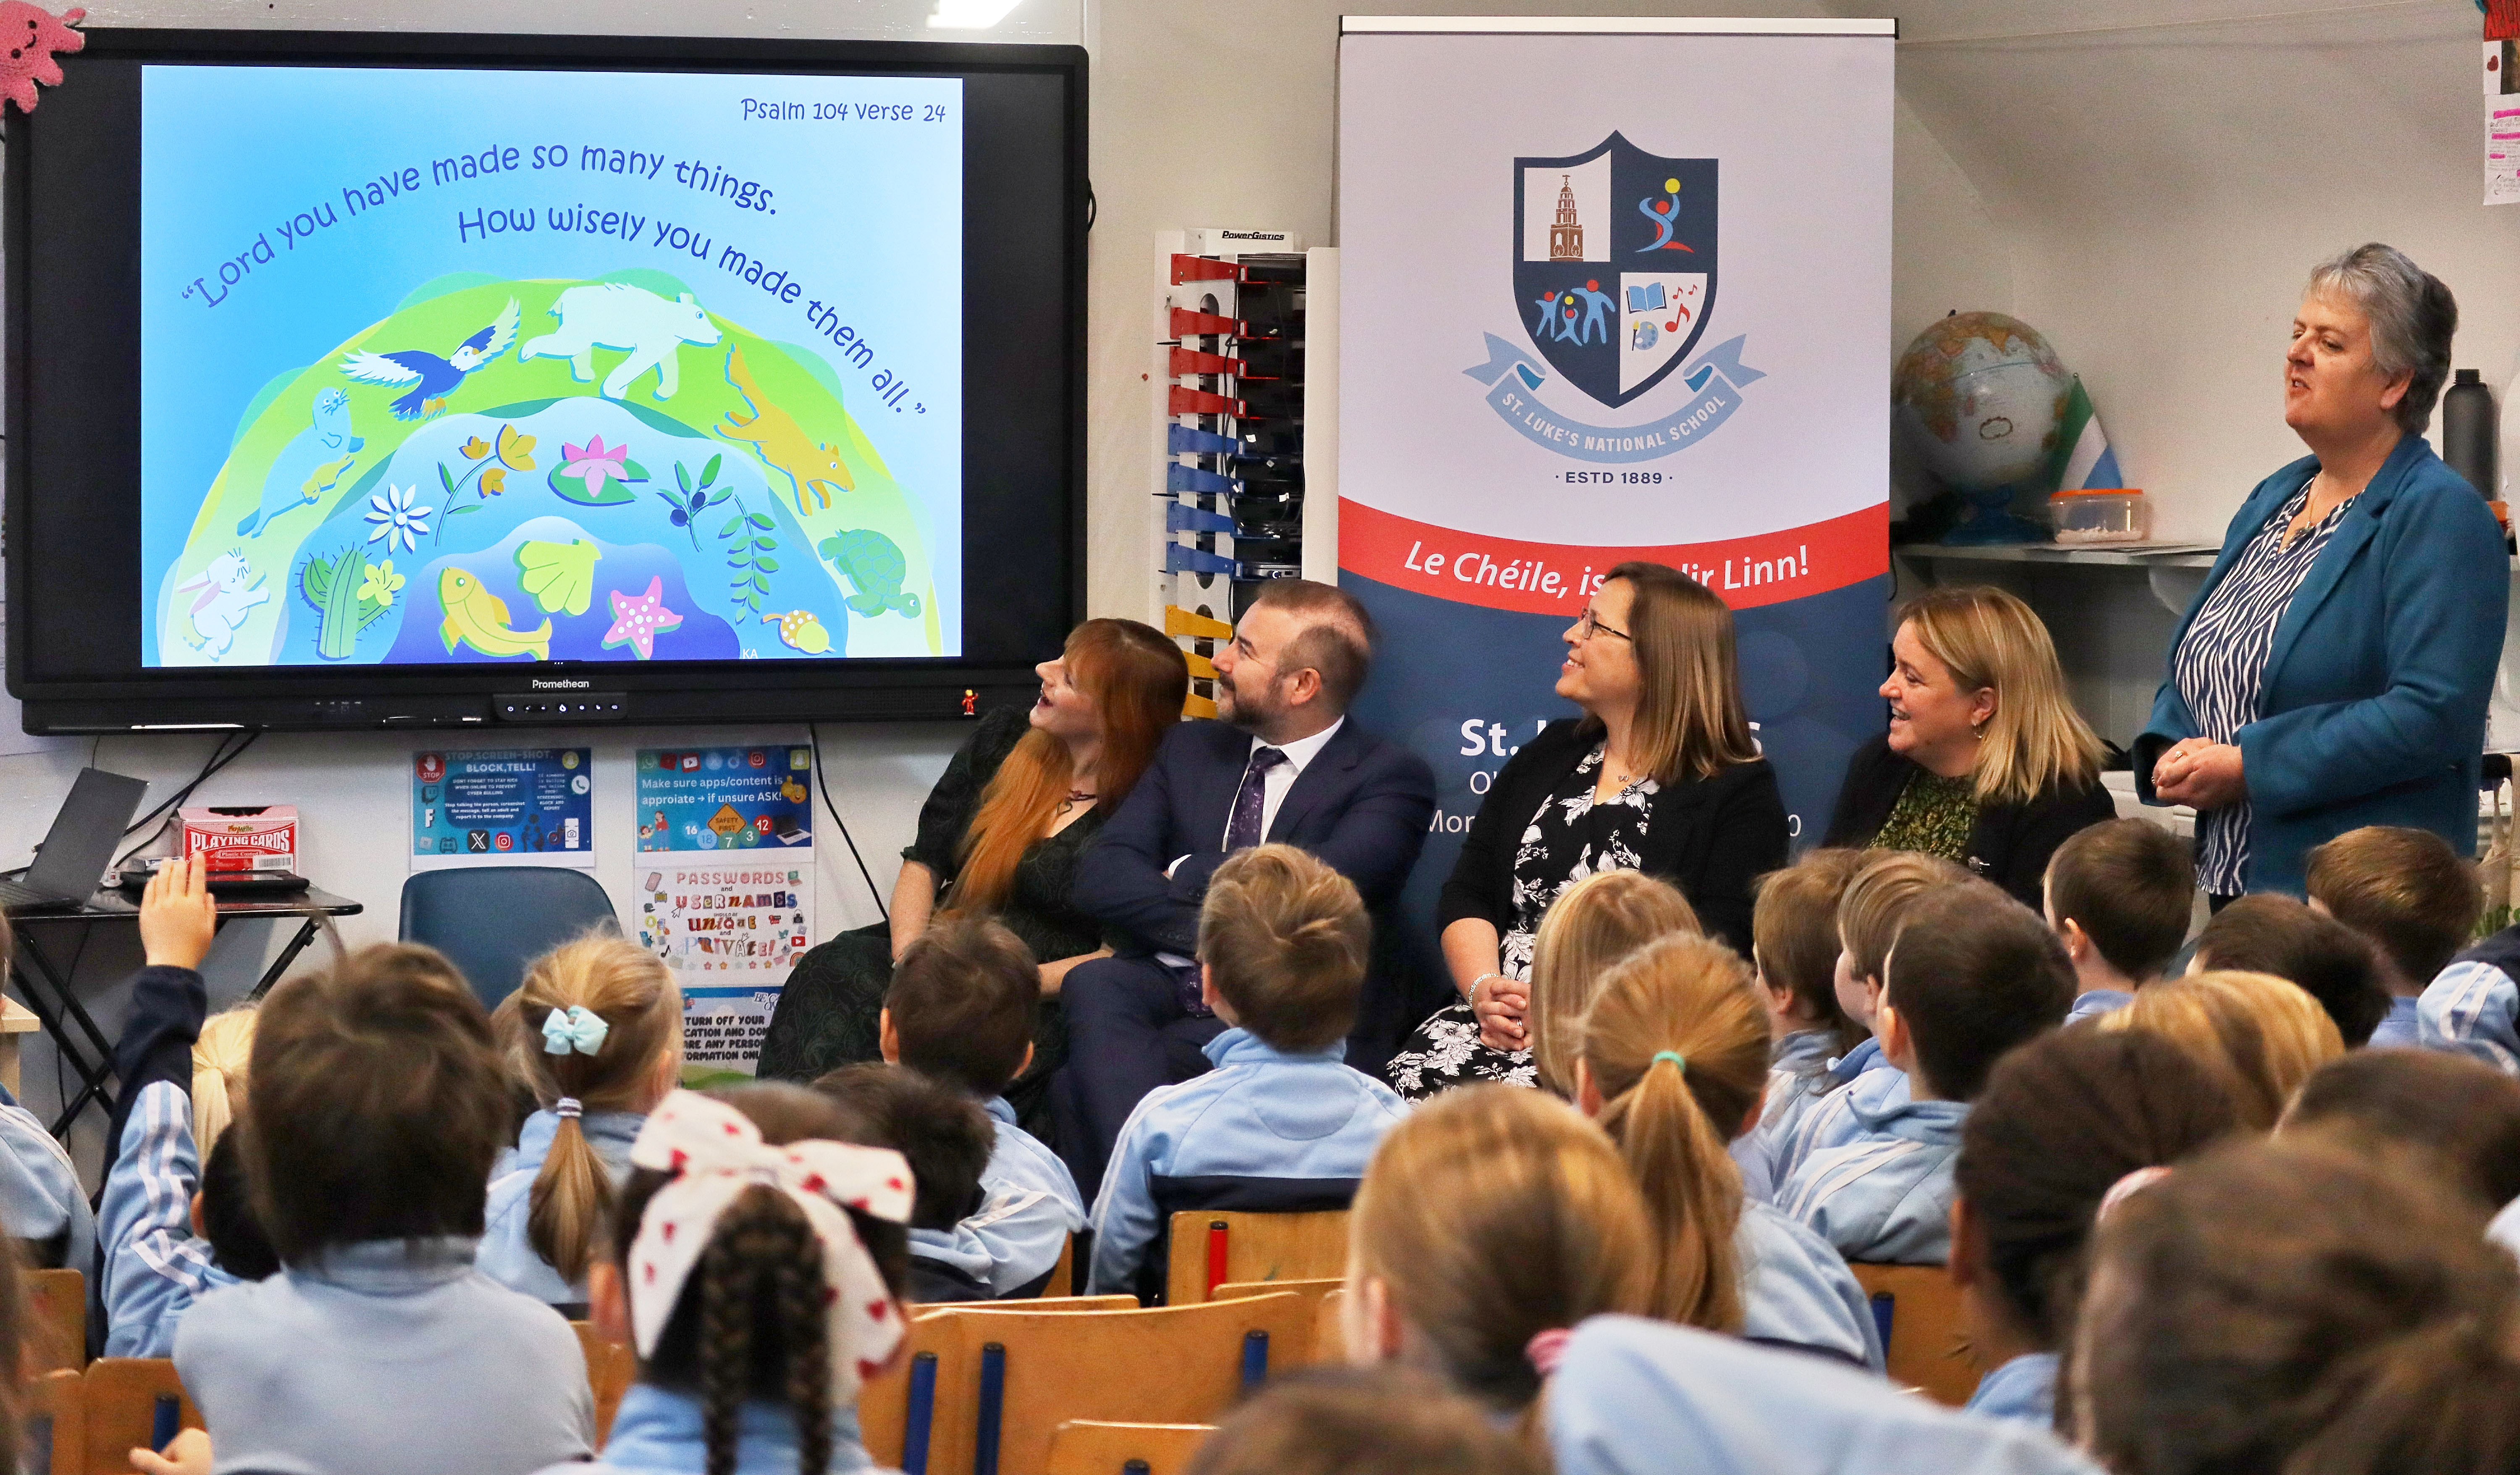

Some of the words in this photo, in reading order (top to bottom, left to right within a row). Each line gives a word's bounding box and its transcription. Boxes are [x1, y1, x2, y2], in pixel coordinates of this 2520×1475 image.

[740, 98, 805, 121] Psalm
[813, 103, 848, 121] 104
[923, 104, 946, 123] 24
[276, 202, 337, 251] you
[342, 167, 420, 216] have
[432, 144, 520, 186] made
[532, 145, 568, 170] so
[581, 145, 665, 180] many
[674, 160, 776, 215] things.
[459, 207, 535, 243] How
[548, 203, 646, 241] wisely
[654, 220, 711, 260] you
[719, 245, 801, 304] made
[806, 299, 874, 369] them
[1502, 393, 1524, 416] ST.
[1584, 433, 1666, 452] NATIONAL
[1669, 396, 1726, 441] SCHOOL
[1565, 472, 1614, 483] ESTD
[1620, 472, 1662, 484] 1889
[1404, 541, 1445, 575] Le
[1453, 552, 1569, 599] Chéile,
[1724, 544, 1809, 590] Linn!
[743, 648, 759, 659] KA
[532, 680, 589, 689] Promethean
[1460, 718, 1519, 756] St.
[642, 779, 670, 788] Make
[700, 777, 772, 789] apps/content
[642, 795, 695, 806] approiate
[707, 793, 716, 803] if
[718, 794, 755, 803] unsure
[757, 792, 782, 801] ASK!
[685, 826, 698, 835] 16
[757, 819, 769, 831] 12
[190, 831, 249, 853] PLAYING
[250, 829, 290, 852] CARDS
[746, 831, 753, 841] 3
[725, 837, 733, 848] 7
[677, 871, 784, 884] PASSWORDS
[685, 1016, 712, 1026] TURN
[716, 1016, 735, 1025] OFF
[738, 1016, 765, 1025] YOUR
[684, 1028, 721, 1037] CATION
[724, 1028, 745, 1037] AND
[684, 1040, 701, 1049] ARE
[705, 1039, 725, 1049] ANY
[729, 1039, 762, 1048] PERSO
[685, 1051, 739, 1060] ORMATION
